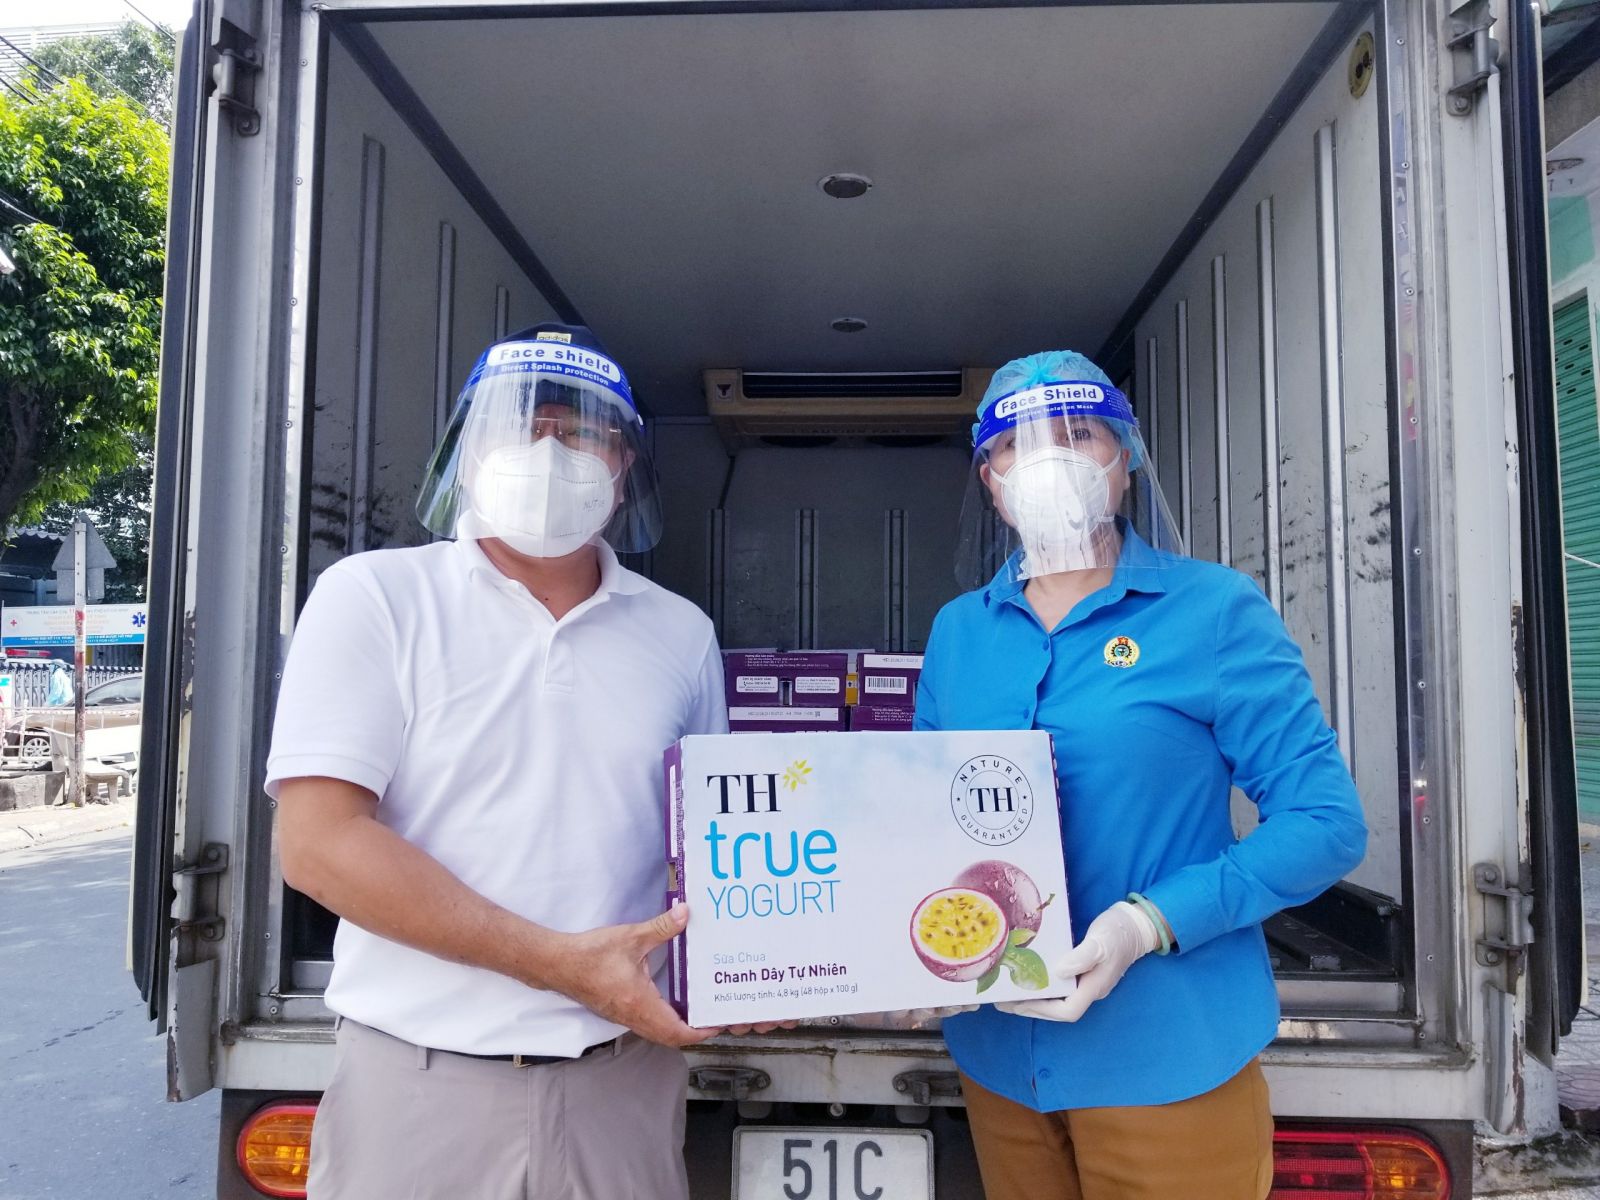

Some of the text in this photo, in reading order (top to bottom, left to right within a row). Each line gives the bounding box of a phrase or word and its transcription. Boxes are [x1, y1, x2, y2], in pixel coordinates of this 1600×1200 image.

[500, 347, 611, 375] Face shield
[531, 362, 563, 372] Splash
[564, 366, 609, 386] protection
[1001, 394, 1037, 414] Face
[1043, 387, 1097, 401] Shield
[959, 760, 1022, 784] NATURE
[706, 773, 782, 815] TH
[969, 787, 1015, 813] TH
[960, 808, 1028, 841] GUARANTEED
[704, 820, 838, 880] true
[707, 880, 841, 920] YOGURT
[737, 951, 766, 963] Chua
[714, 963, 847, 985] Chanh Dây Tự Nhiên
[776, 988, 789, 998] 4,8
[790, 987, 799, 998] kg
[836, 984, 849, 993] 100
[783, 1139, 883, 1200] 51C
